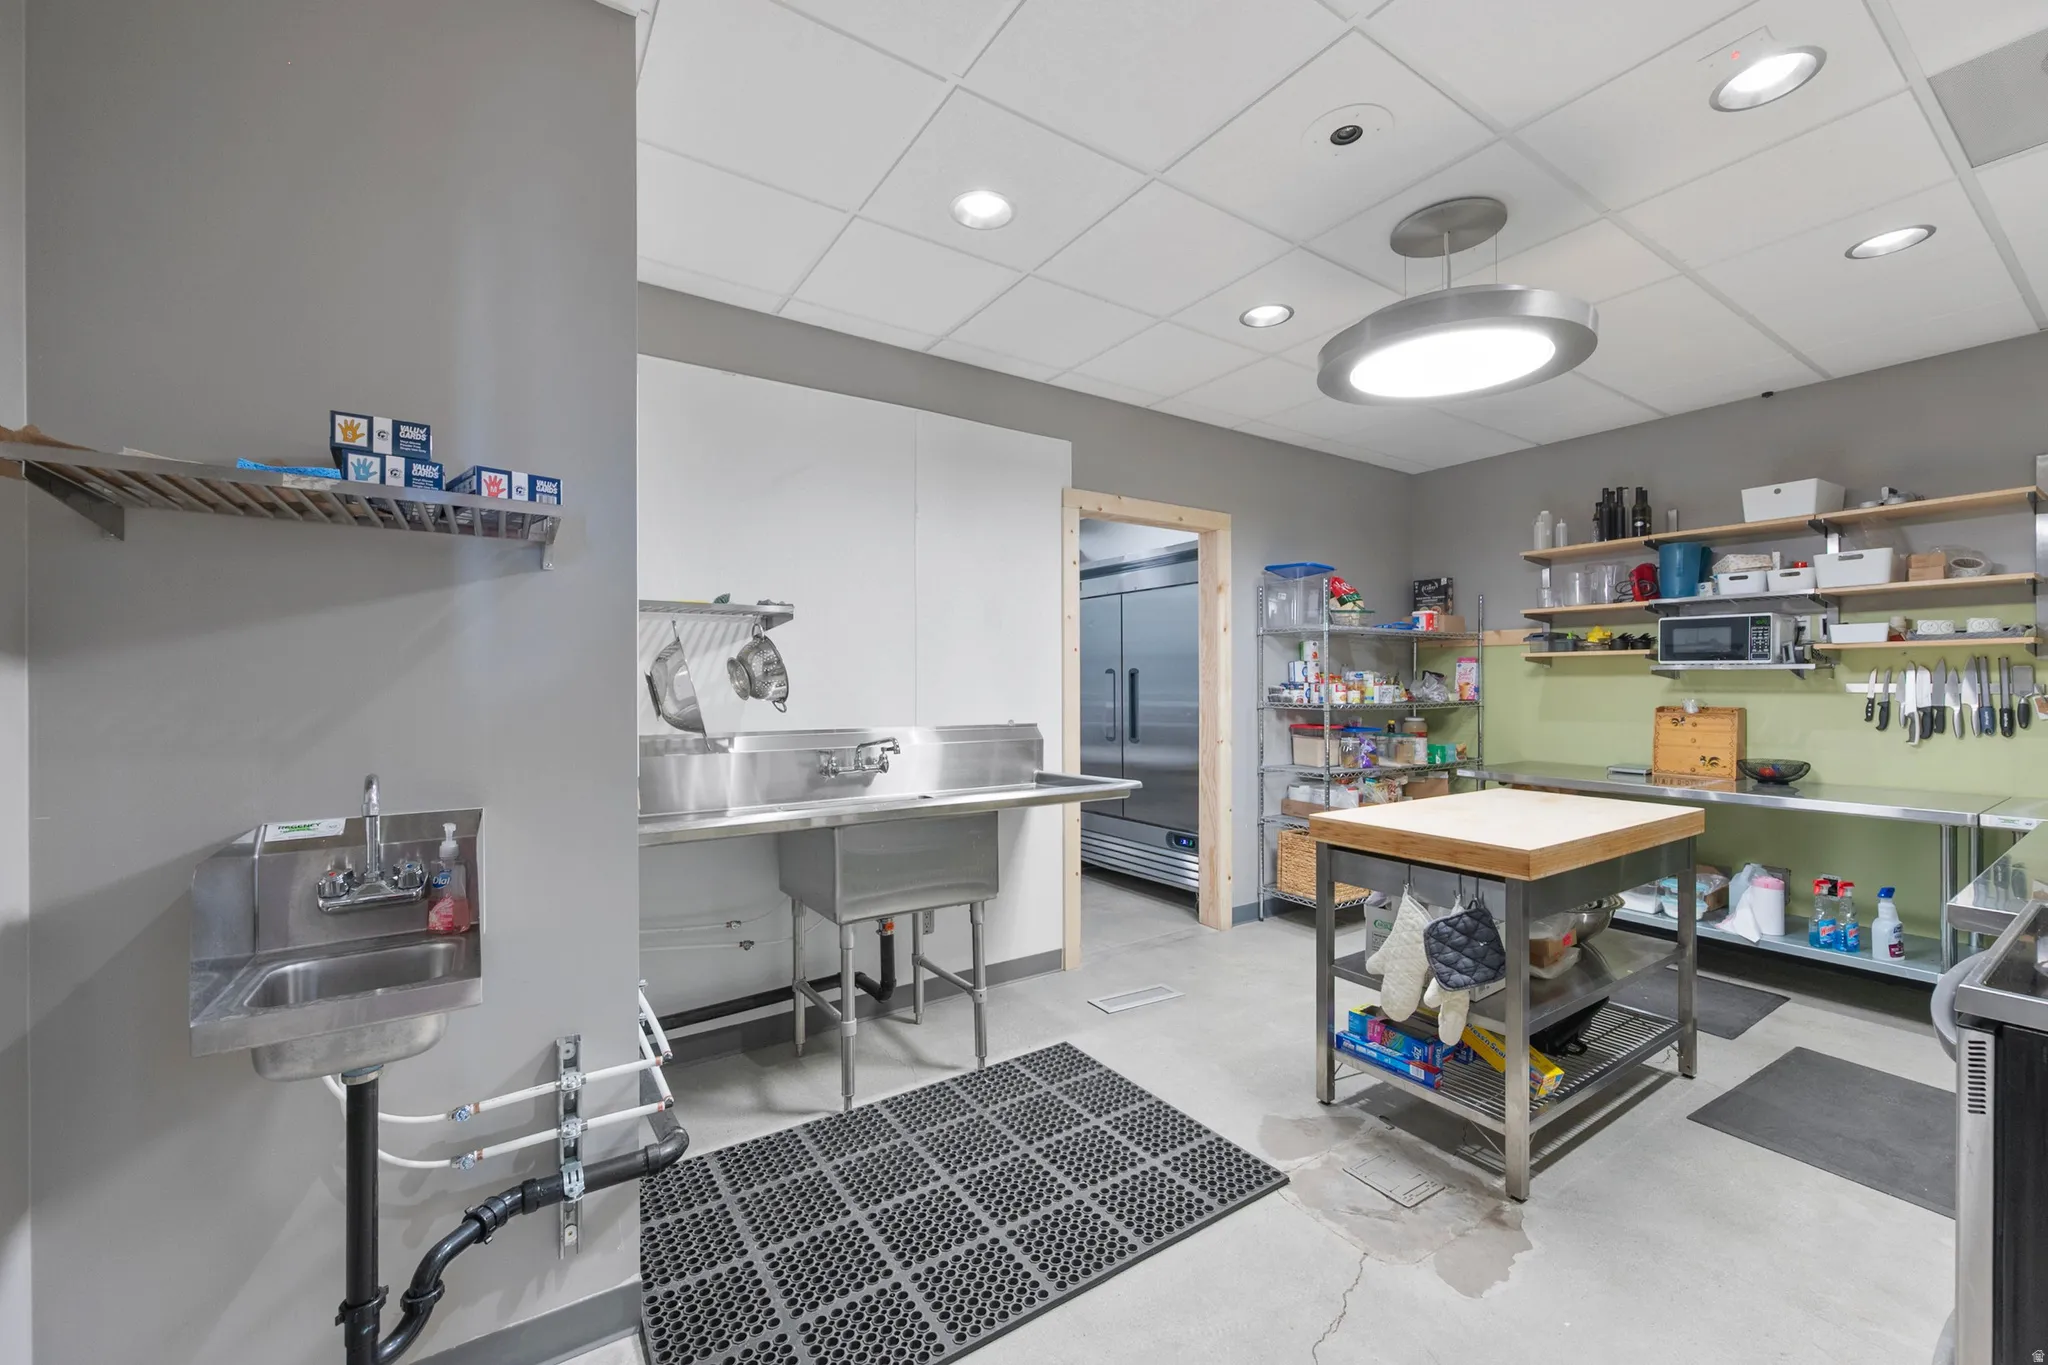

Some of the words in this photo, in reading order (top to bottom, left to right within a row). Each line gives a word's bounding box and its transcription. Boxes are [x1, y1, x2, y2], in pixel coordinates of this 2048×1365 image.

[400, 424, 420, 434] VALU
[399, 431, 427, 441] GARDS
[412, 463, 432, 472] VALU
[412, 470, 439, 479] GARDS
[536, 485, 558, 494] GARDS
[432, 876, 450, 885] Dial
[1489, 1042, 1506, 1059] Seal
